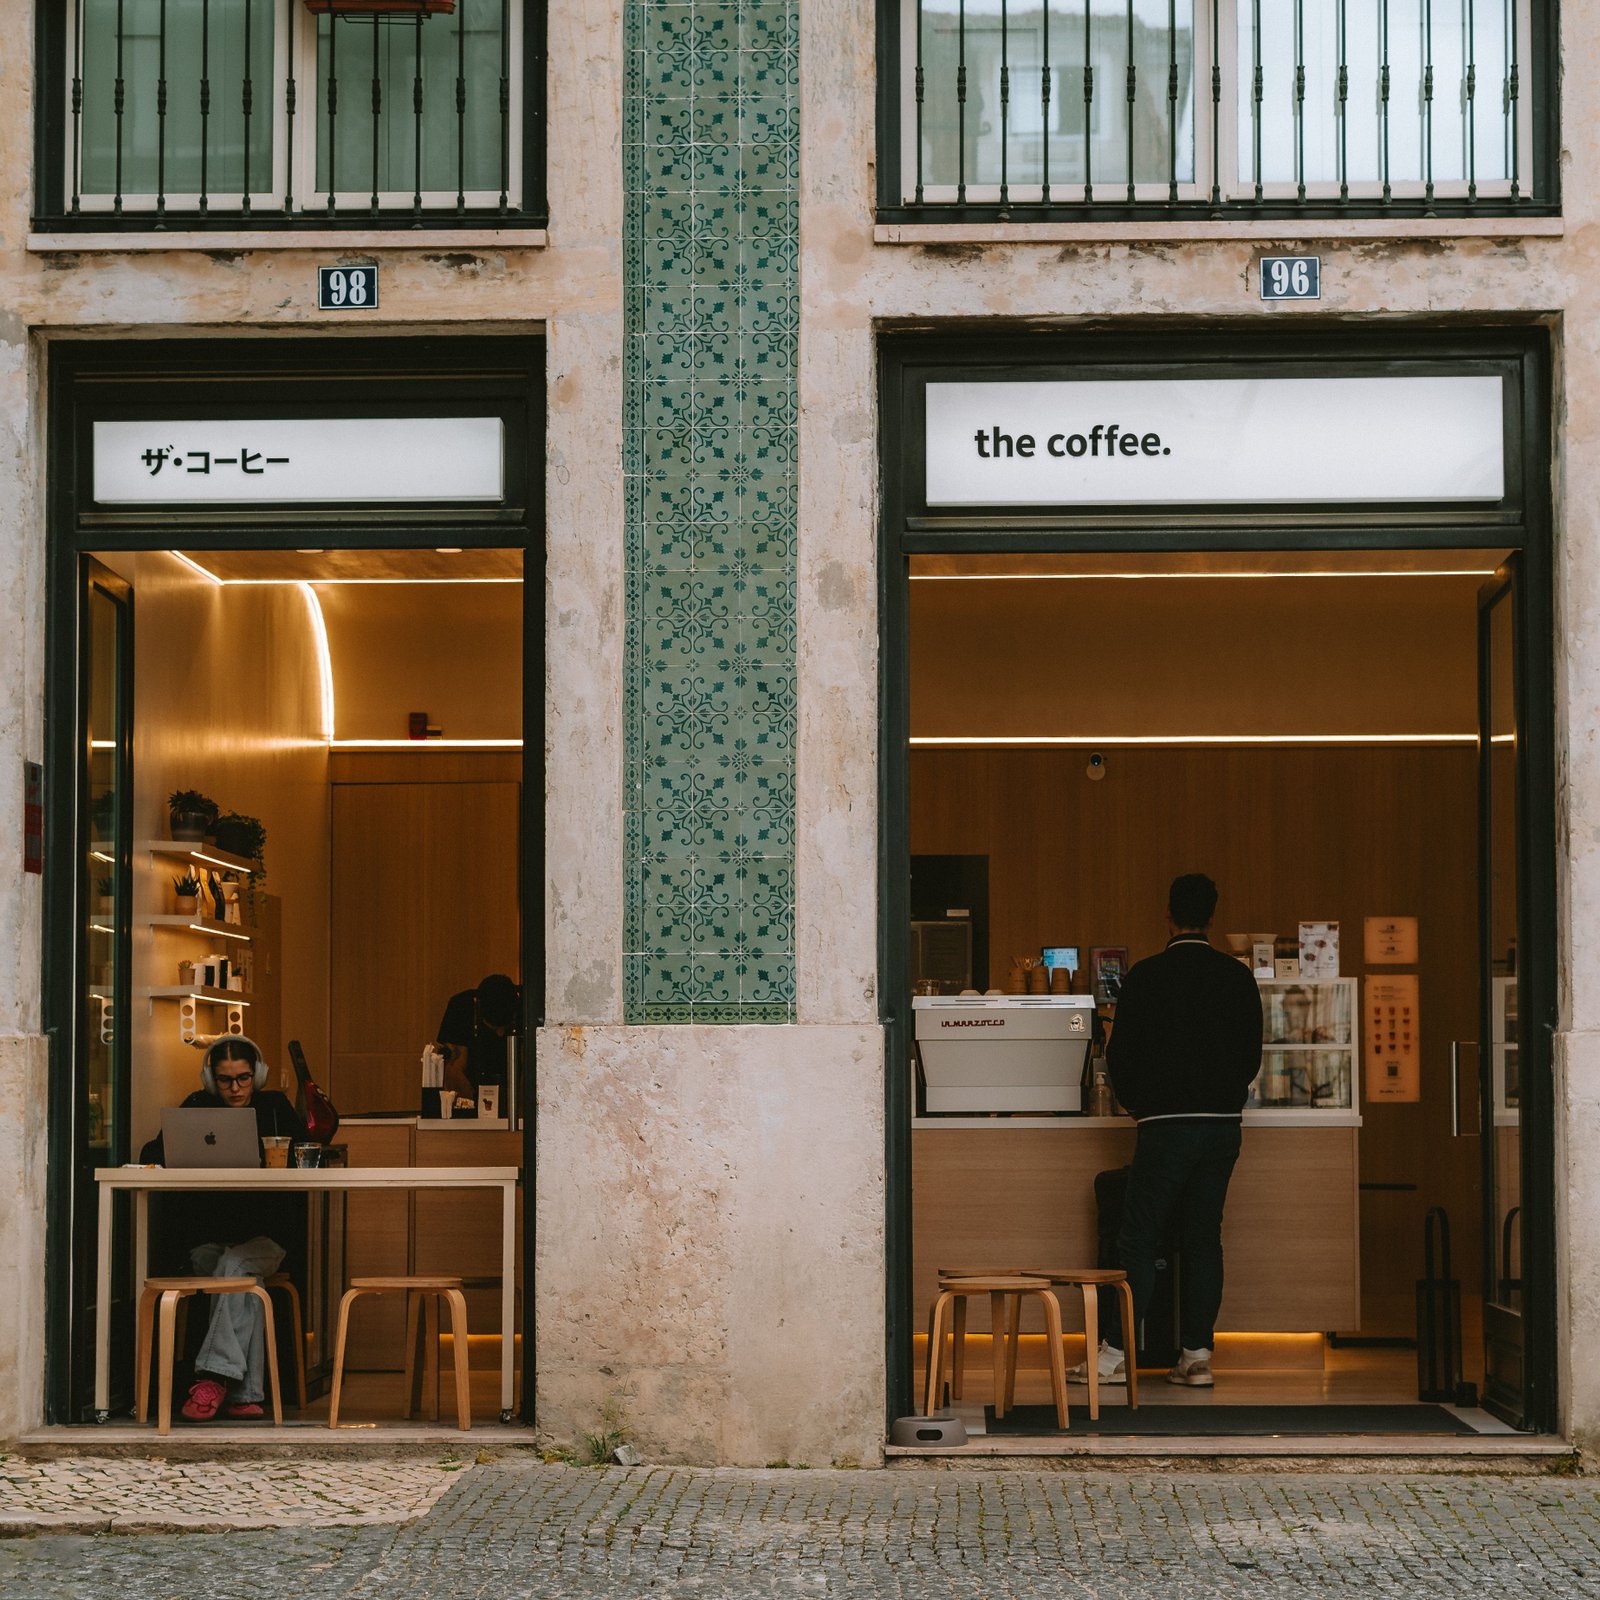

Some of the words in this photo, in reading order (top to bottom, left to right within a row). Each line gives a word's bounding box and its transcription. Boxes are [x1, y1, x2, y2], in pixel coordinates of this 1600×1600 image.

[329, 270, 367, 305] 98
[1271, 260, 1310, 296] 96
[974, 426, 1036, 458] the
[1046, 424, 1171, 458] coffee.
[140, 444, 290, 477] ザ・コーヒー
